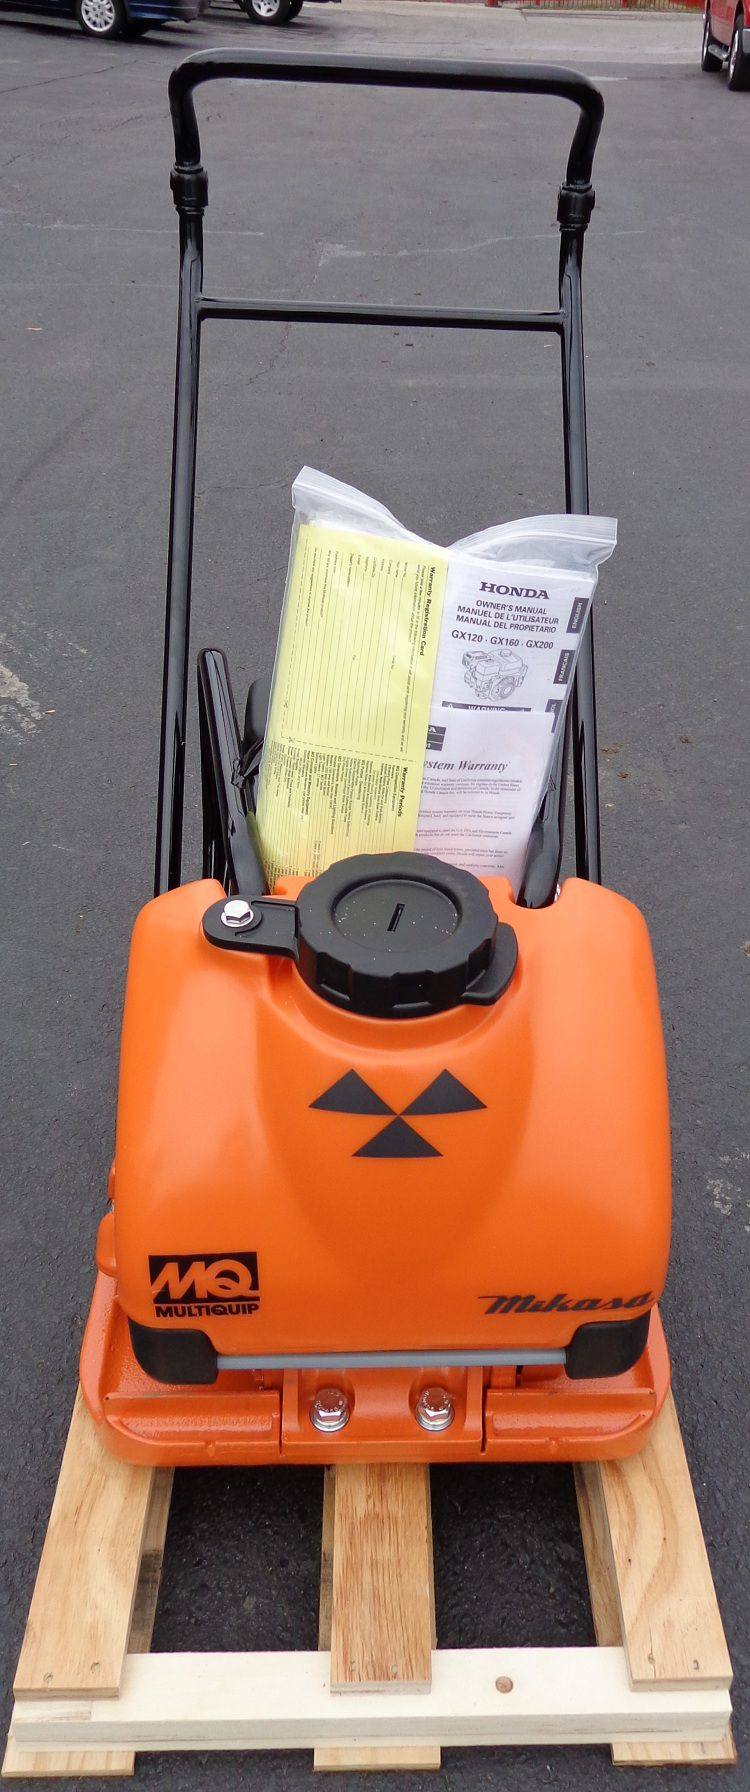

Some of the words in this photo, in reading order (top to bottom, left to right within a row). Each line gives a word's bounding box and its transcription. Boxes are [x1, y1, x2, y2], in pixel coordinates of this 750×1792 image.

[427, 566, 436, 597] Warranty
[479, 581, 550, 600] HONDA
[457, 606, 493, 618] MANUEL
[494, 612, 505, 620] DE
[506, 613, 559, 625] L'UTILISATEUR
[476, 600, 513, 612] OWNER'S
[515, 605, 547, 615] MANUAL
[421, 598, 432, 638] Registration
[456, 615, 492, 628] MANUAL
[493, 621, 508, 630] DEL
[509, 623, 557, 634] PROPIETARIO
[451, 629, 483, 643] GX120
[490, 636, 519, 647] GX160
[526, 639, 554, 650] GX200
[459, 760, 508, 774] Warranty
[400, 767, 409, 794] Warranty
[149, 1257, 260, 1300] MQ
[155, 1303, 260, 1318] MULTIQUIP
[478, 1291, 654, 1315] Mikasa
